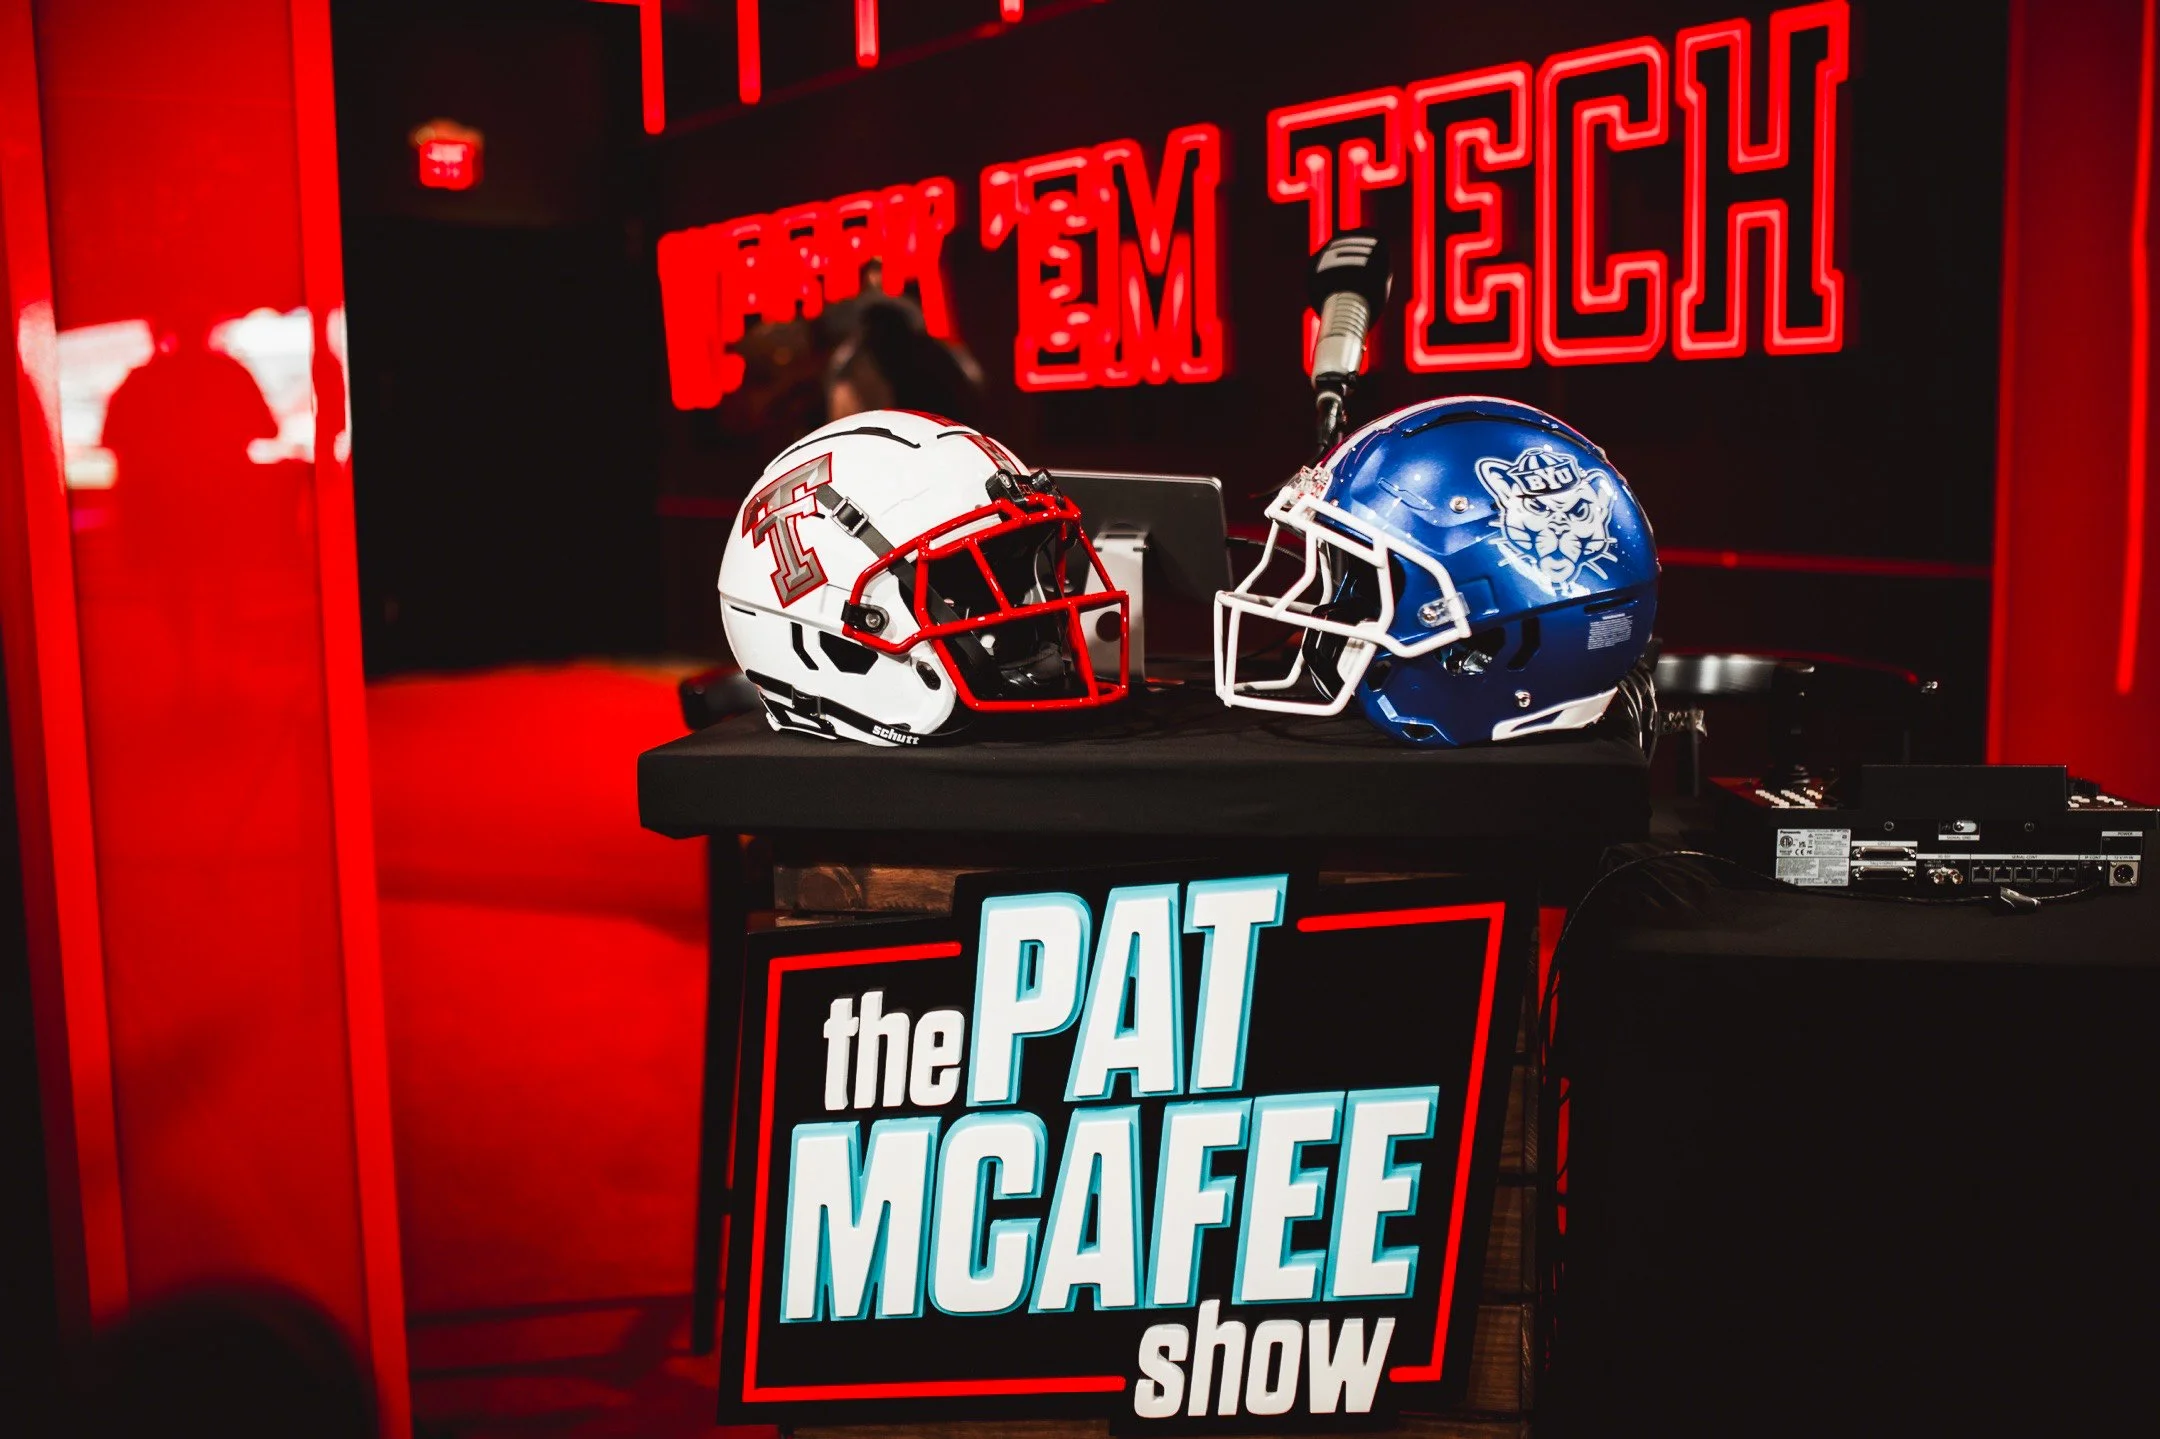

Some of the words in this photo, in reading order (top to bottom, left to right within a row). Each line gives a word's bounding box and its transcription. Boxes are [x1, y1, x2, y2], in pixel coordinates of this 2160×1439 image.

[1267, 0, 1850, 374] TECH
[1524, 467, 1573, 491] BYU
[872, 725, 920, 745] schutt
[823, 990, 964, 1111] the
[966, 874, 1289, 1106] PAT
[780, 1086, 1440, 1324] MCAFEE
[1133, 1299, 1395, 1418] show
